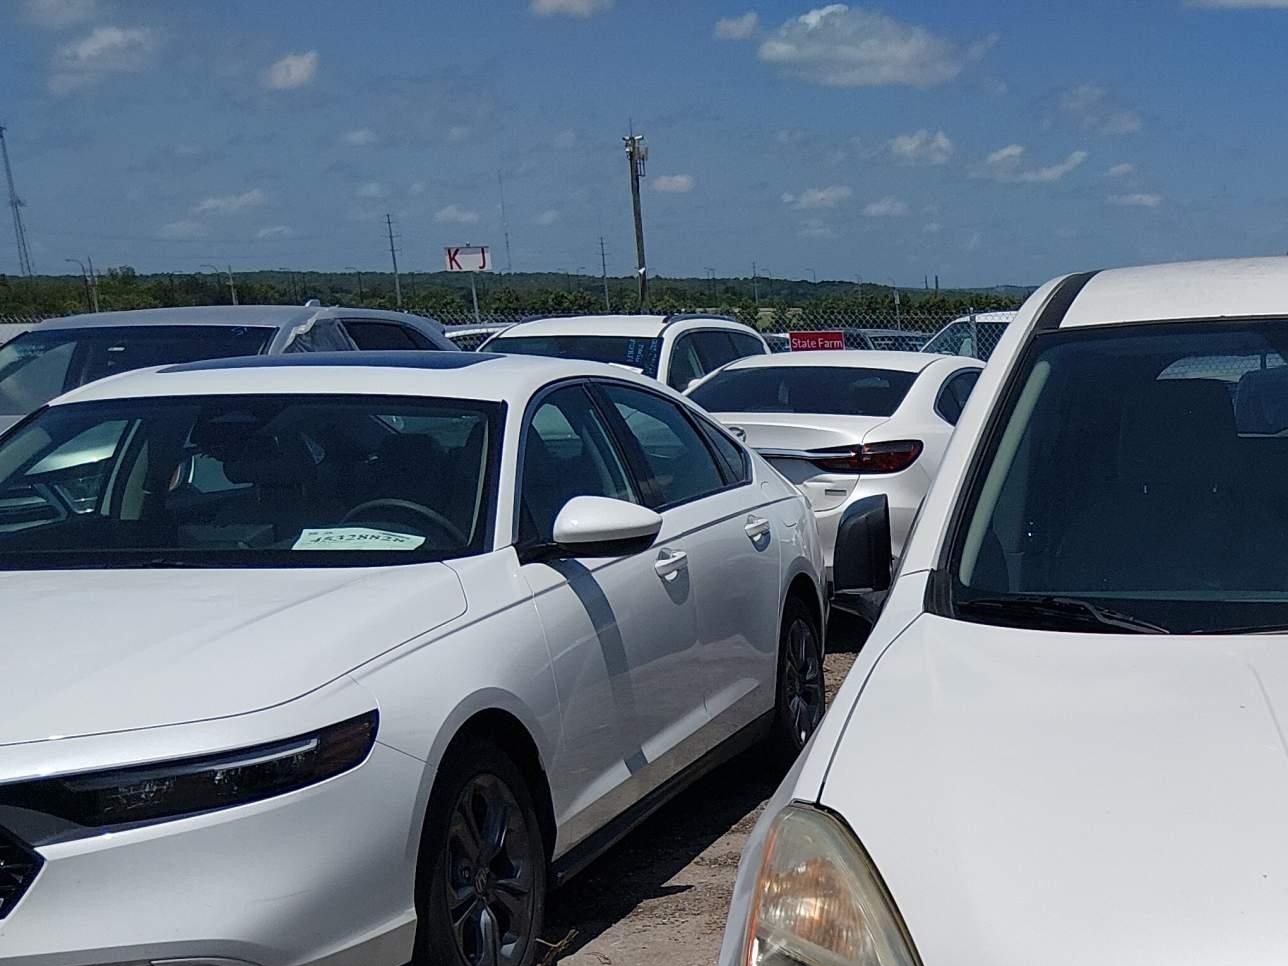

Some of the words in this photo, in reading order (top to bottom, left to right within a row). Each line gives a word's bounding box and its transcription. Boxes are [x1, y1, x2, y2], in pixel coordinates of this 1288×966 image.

[447, 248, 463, 270] K
[479, 247, 487, 270] J
[791, 338, 817, 349] State
[818, 337, 843, 349] Farm
